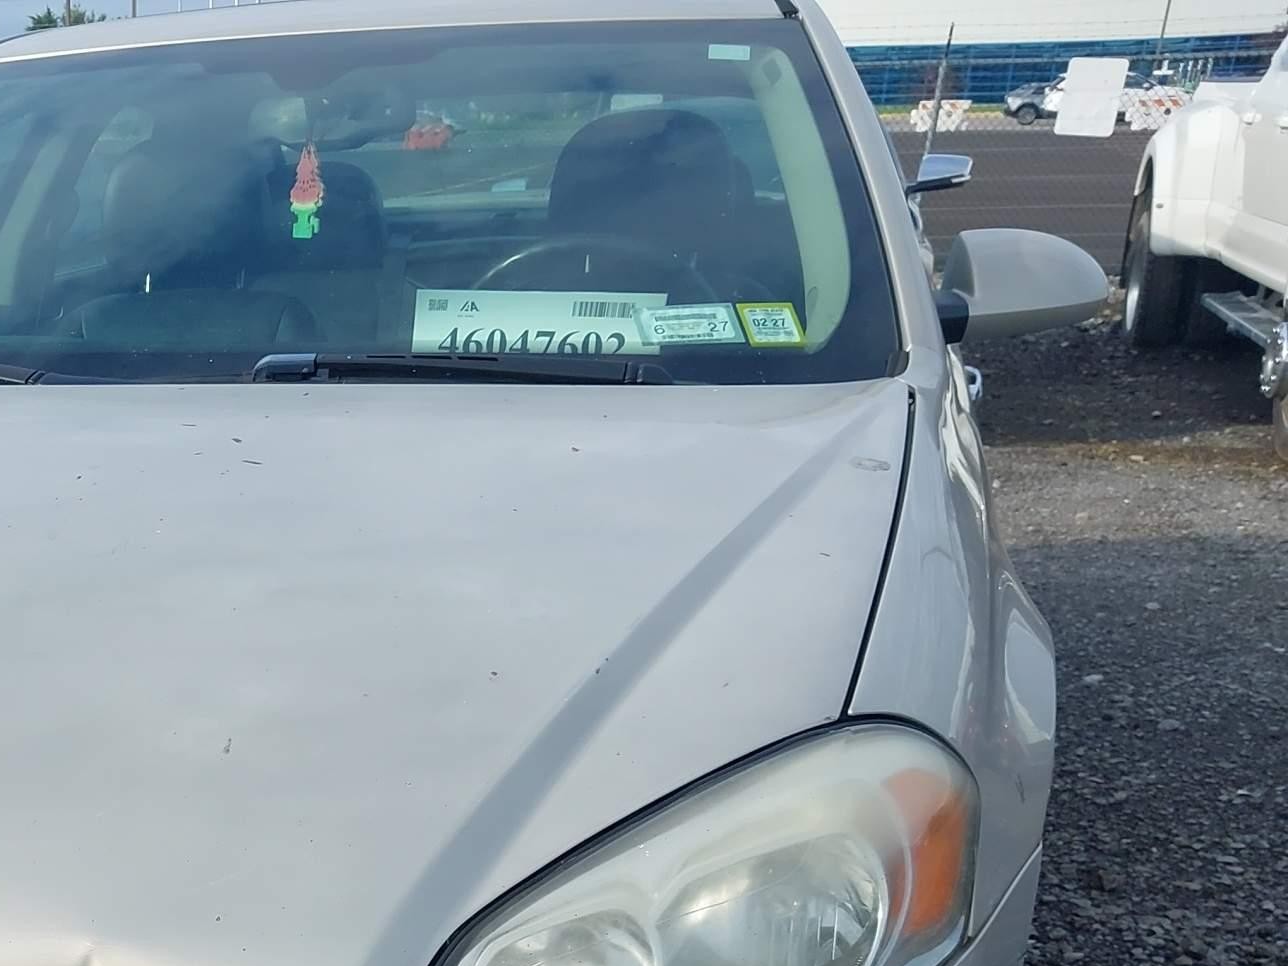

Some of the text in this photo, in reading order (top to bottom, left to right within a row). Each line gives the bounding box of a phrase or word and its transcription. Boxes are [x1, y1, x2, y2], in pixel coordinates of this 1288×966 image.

[654, 320, 729, 335] 6 27
[752, 317, 786, 328] 02 27
[438, 327, 626, 354] 46047602
